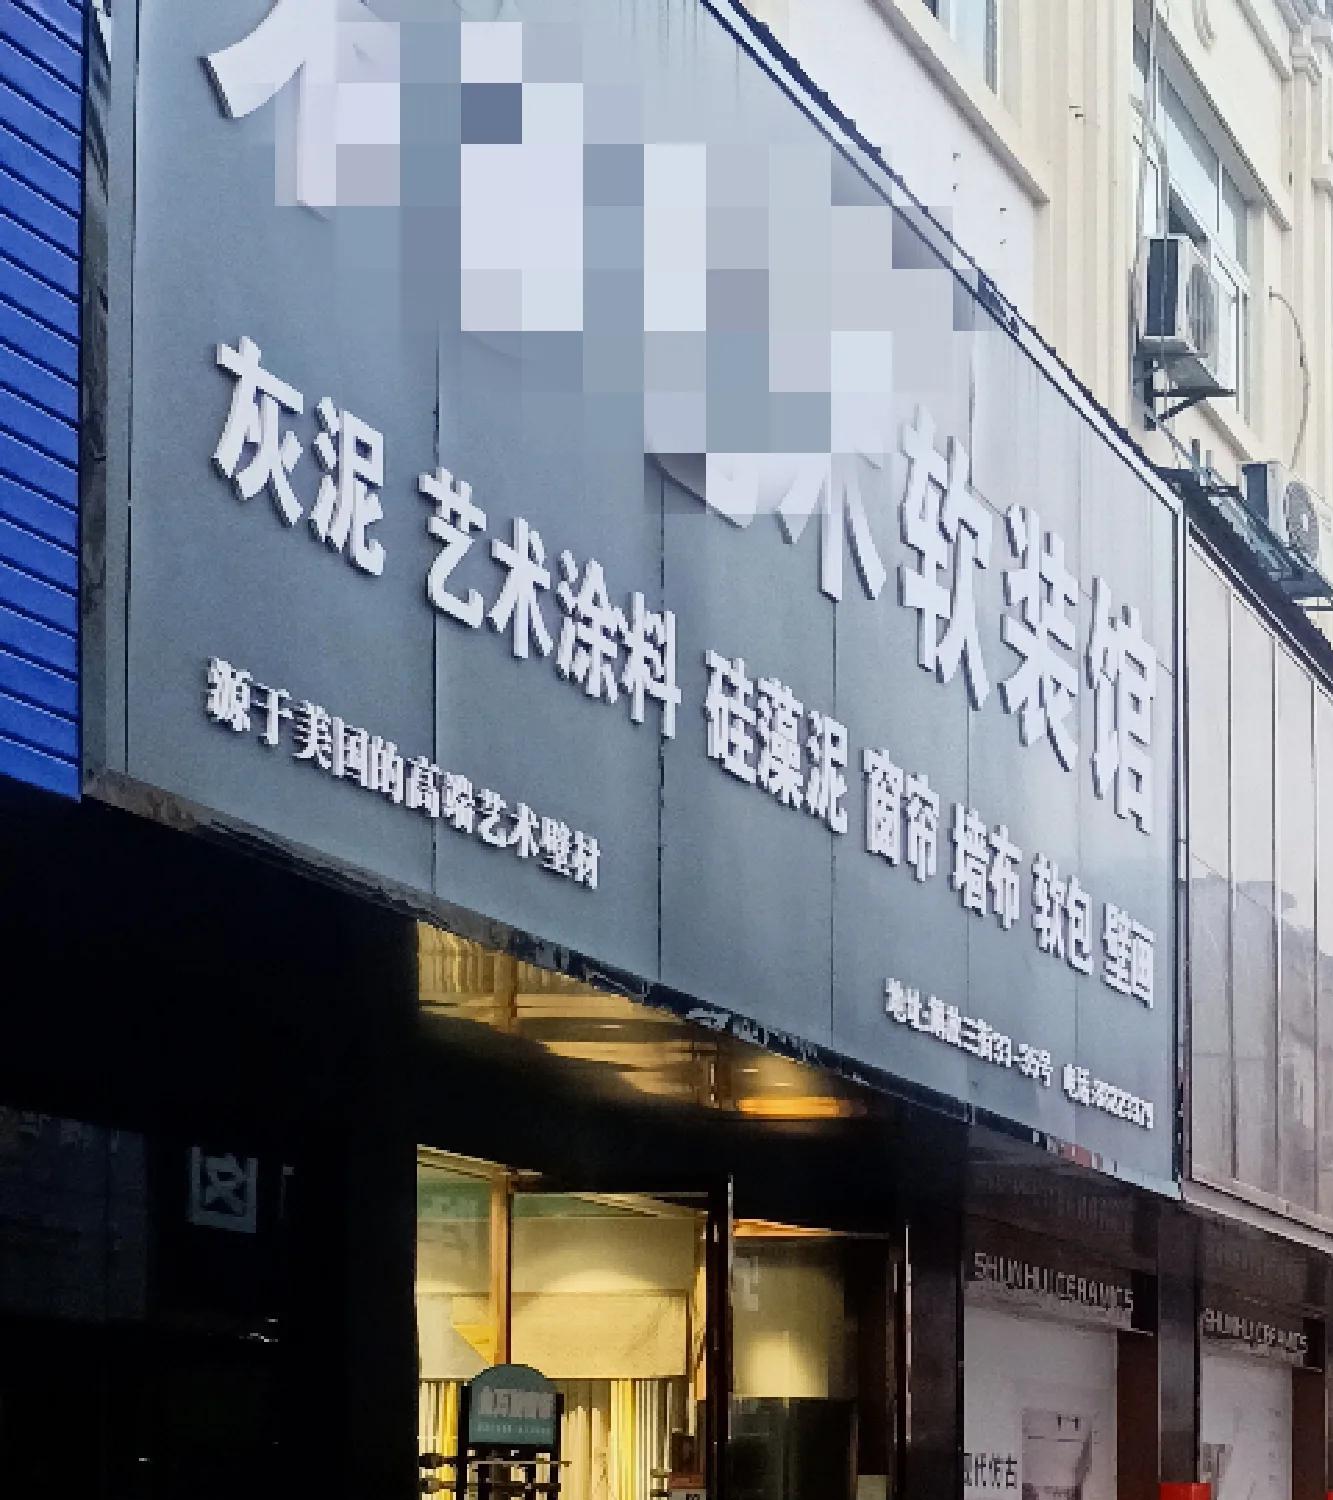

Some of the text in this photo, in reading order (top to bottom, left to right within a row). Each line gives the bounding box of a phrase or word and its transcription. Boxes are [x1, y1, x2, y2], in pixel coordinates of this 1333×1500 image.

[212, 335, 385, 577] 灰泥
[417, 466, 682, 740] 艺术涂料
[862, 747, 940, 884] 窗帘
[950, 802, 1022, 931] 墙布
[1031, 853, 1092, 977] 软包
